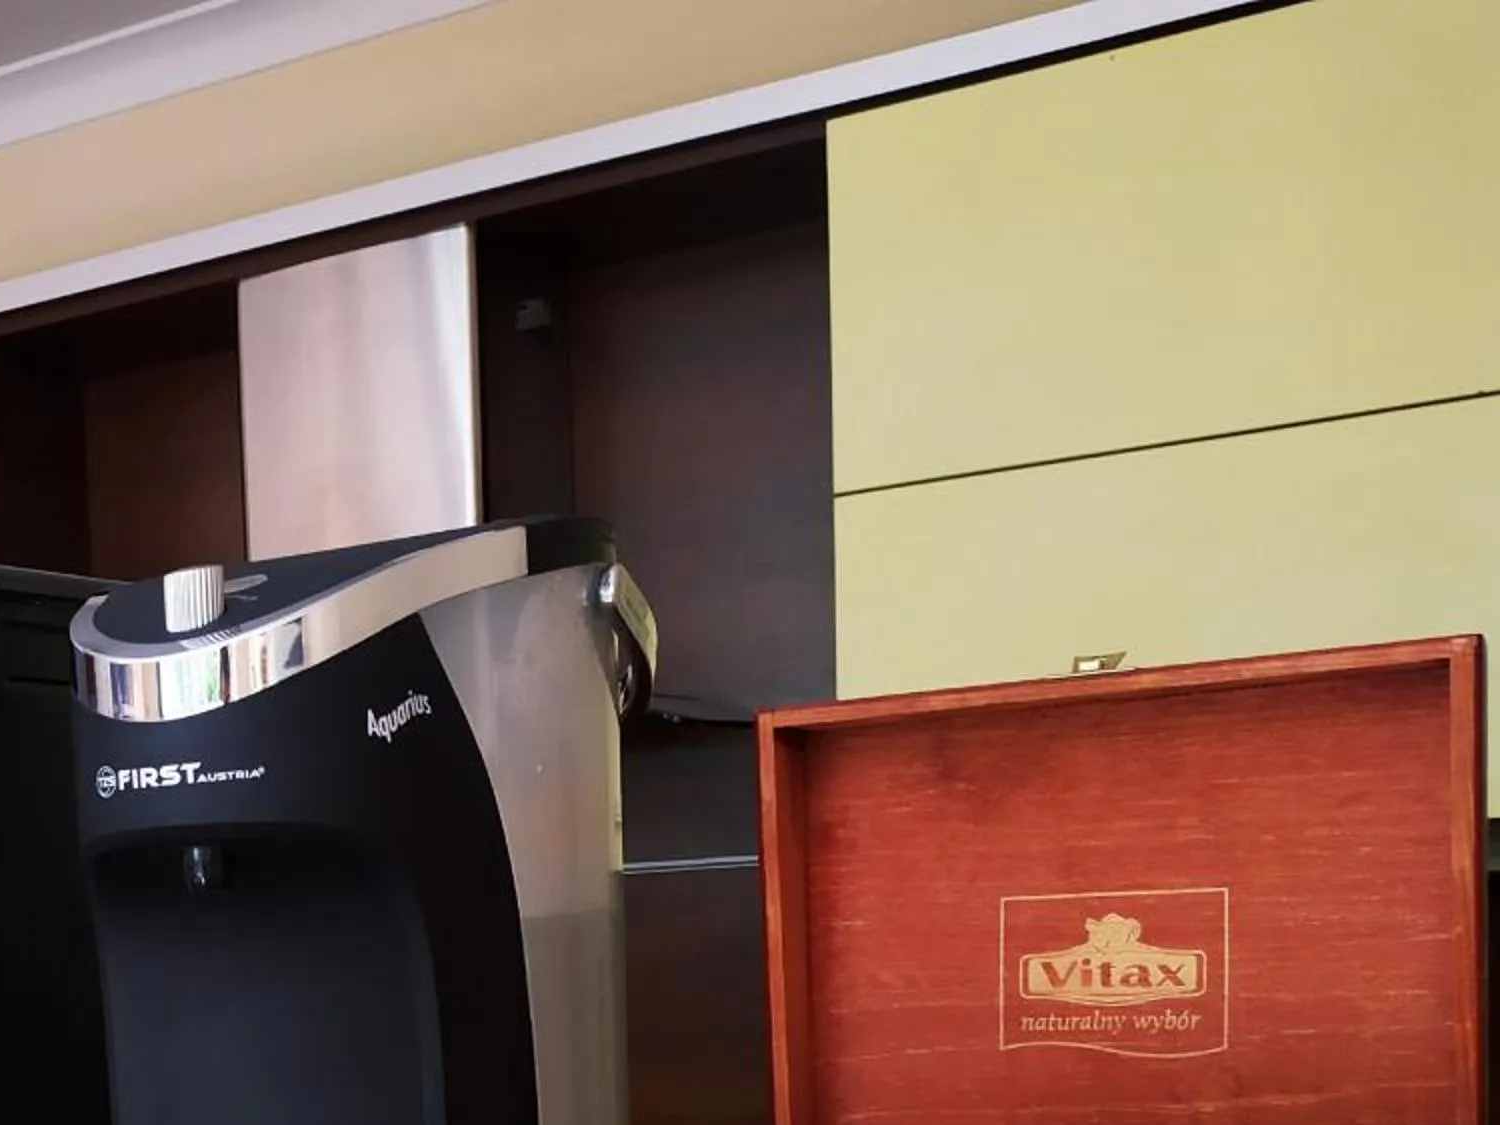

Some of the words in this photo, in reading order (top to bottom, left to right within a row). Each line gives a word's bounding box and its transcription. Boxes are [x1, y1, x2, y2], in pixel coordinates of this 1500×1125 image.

[367, 689, 432, 743] Aquarius
[118, 761, 201, 791] FIRST
[1040, 957, 1186, 989] Vitax
[1020, 1010, 1127, 1035] naturalny
[1132, 1008, 1202, 1034] wybór
